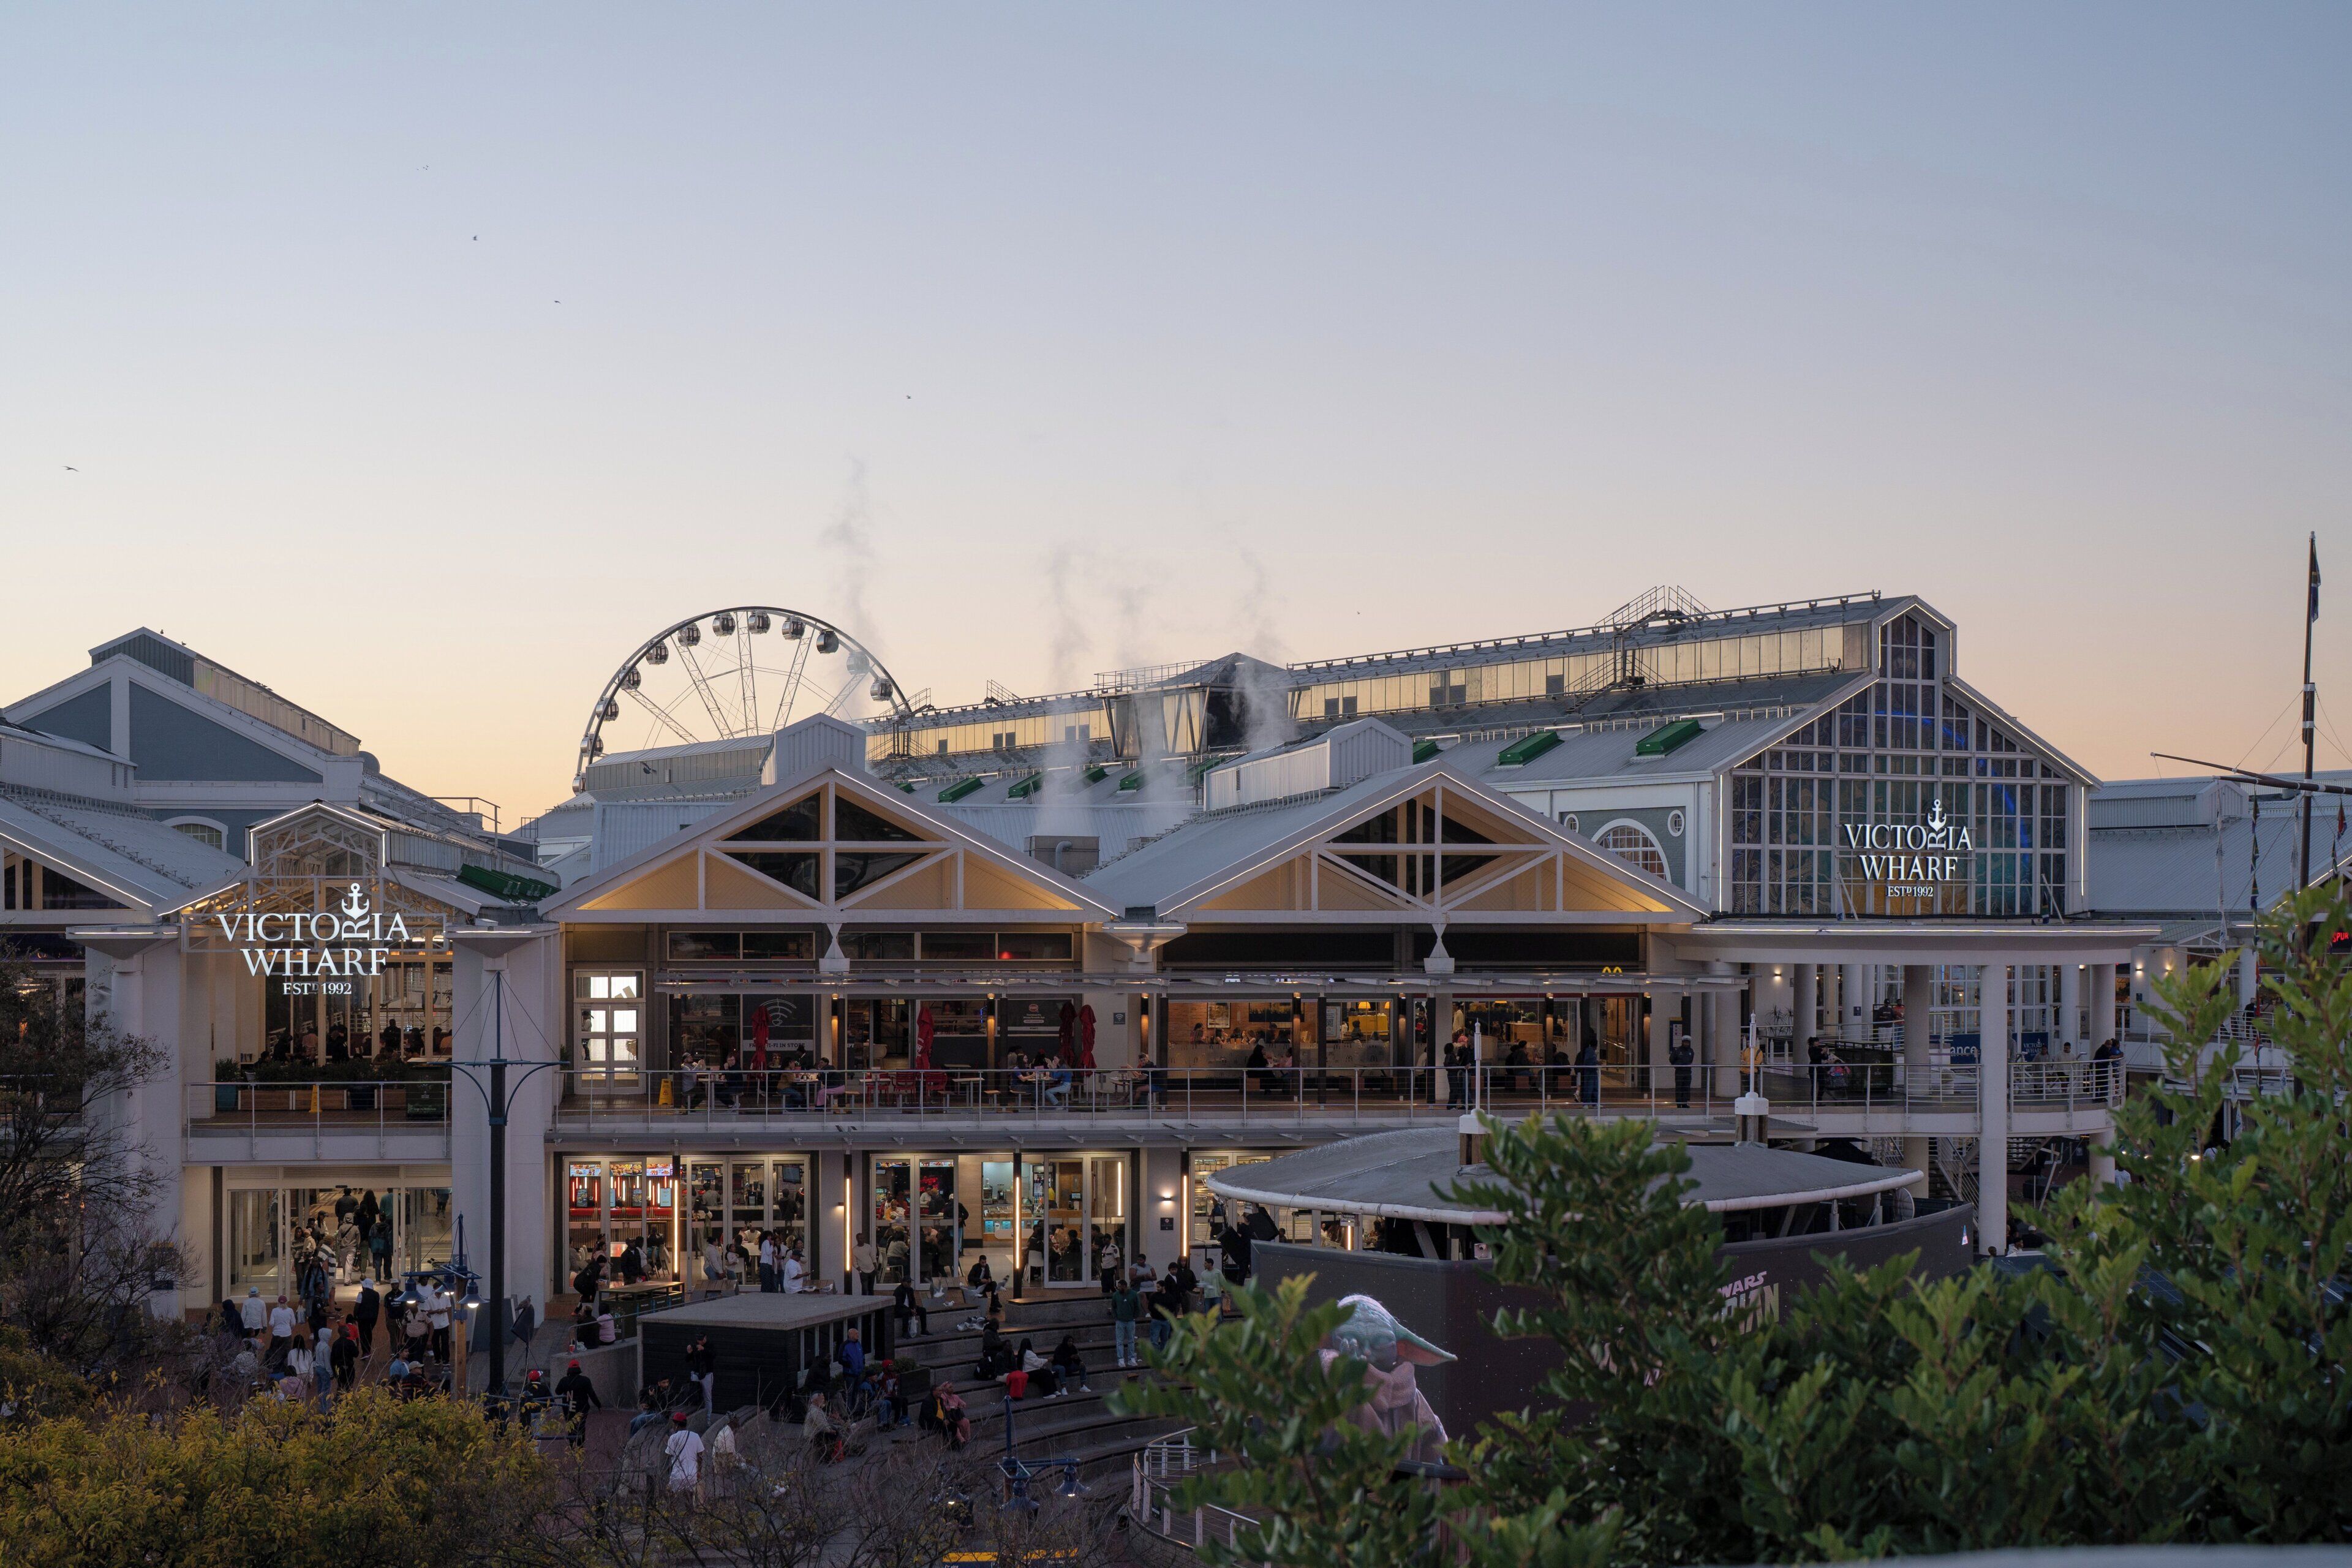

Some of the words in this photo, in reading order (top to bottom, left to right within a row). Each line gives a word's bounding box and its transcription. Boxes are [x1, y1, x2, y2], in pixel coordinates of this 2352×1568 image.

[1844, 823, 1973, 851] VICTORIA
[1858, 855, 1958, 881] WHARF
[1912, 886, 1934, 897] 1992
[215, 912, 410, 942] VICTORIA
[2332, 931, 2350, 943] SPUR
[239, 948, 389, 977] WHARF
[321, 982, 352, 995] 1992
[1716, 1271, 1767, 1298] WARS
